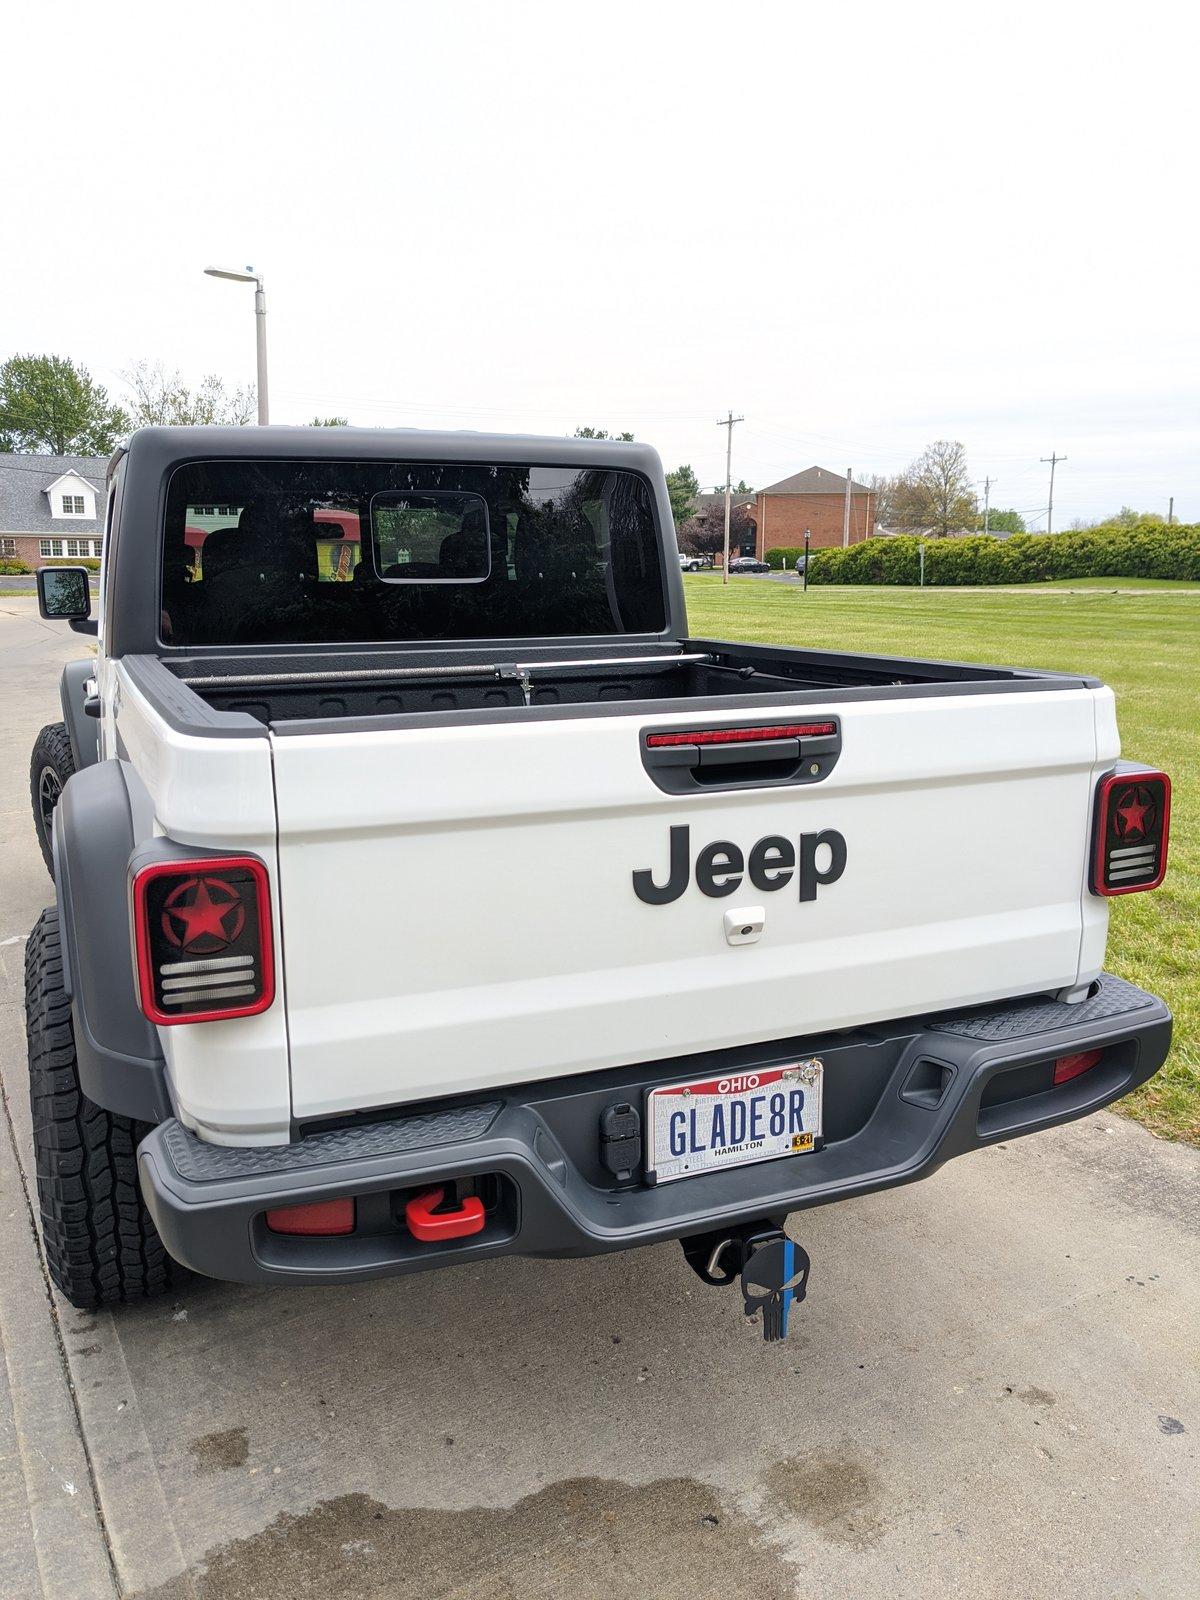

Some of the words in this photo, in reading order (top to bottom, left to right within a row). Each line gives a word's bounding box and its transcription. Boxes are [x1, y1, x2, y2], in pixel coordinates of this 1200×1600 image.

[632, 823, 848, 905] Jeep
[718, 1075, 760, 1094] OHIO
[669, 1089, 805, 1157] GLADE8R
[714, 1141, 763, 1157] HAMILTON
